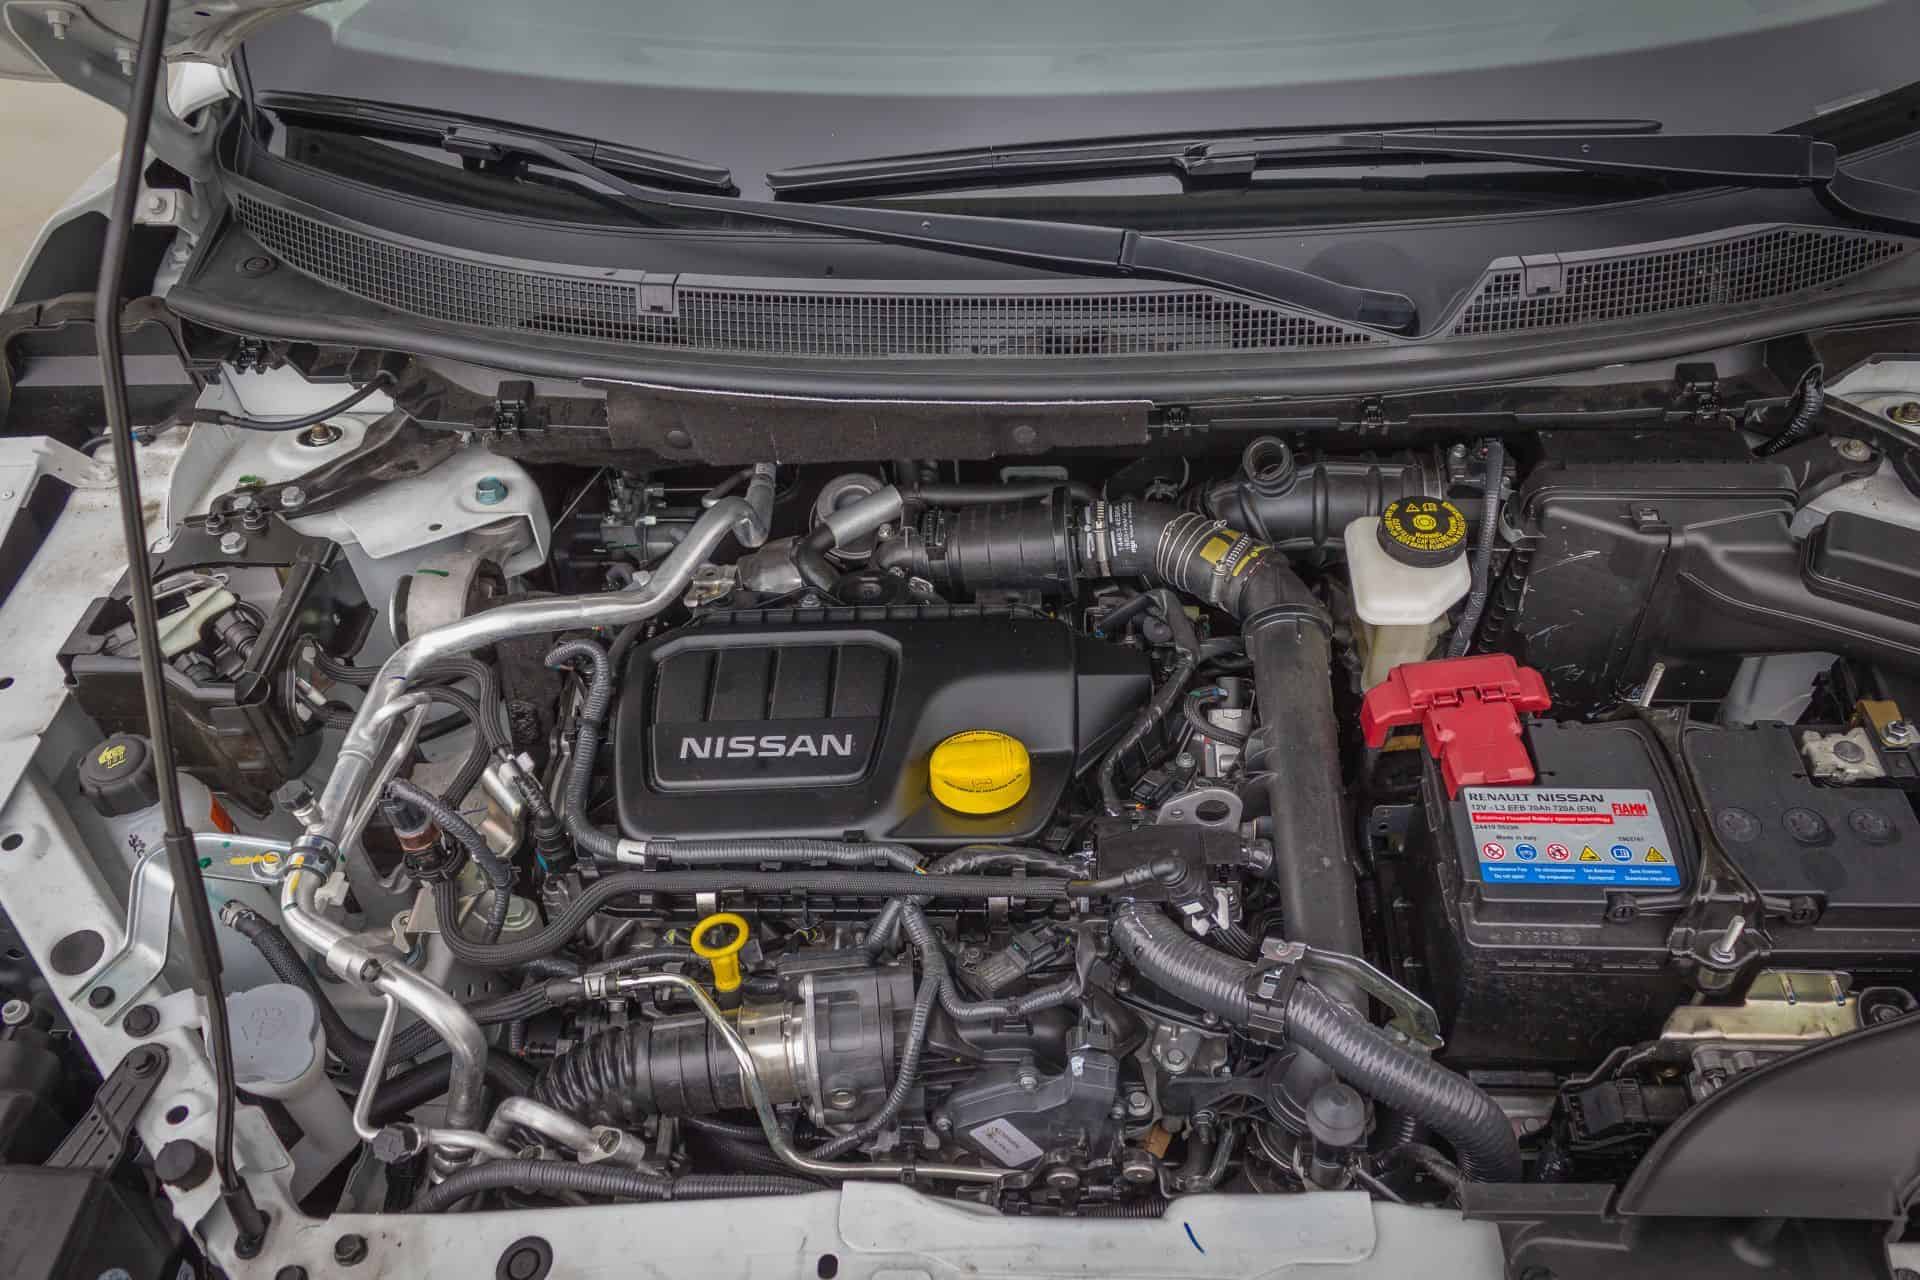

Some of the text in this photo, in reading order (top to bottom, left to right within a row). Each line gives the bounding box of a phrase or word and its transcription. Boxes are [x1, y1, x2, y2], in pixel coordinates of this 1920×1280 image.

[680, 734, 852, 759] NISSAN
[1469, 793, 1605, 803] RENAULT NISSAN
[1611, 803, 1649, 816] FIAMM
